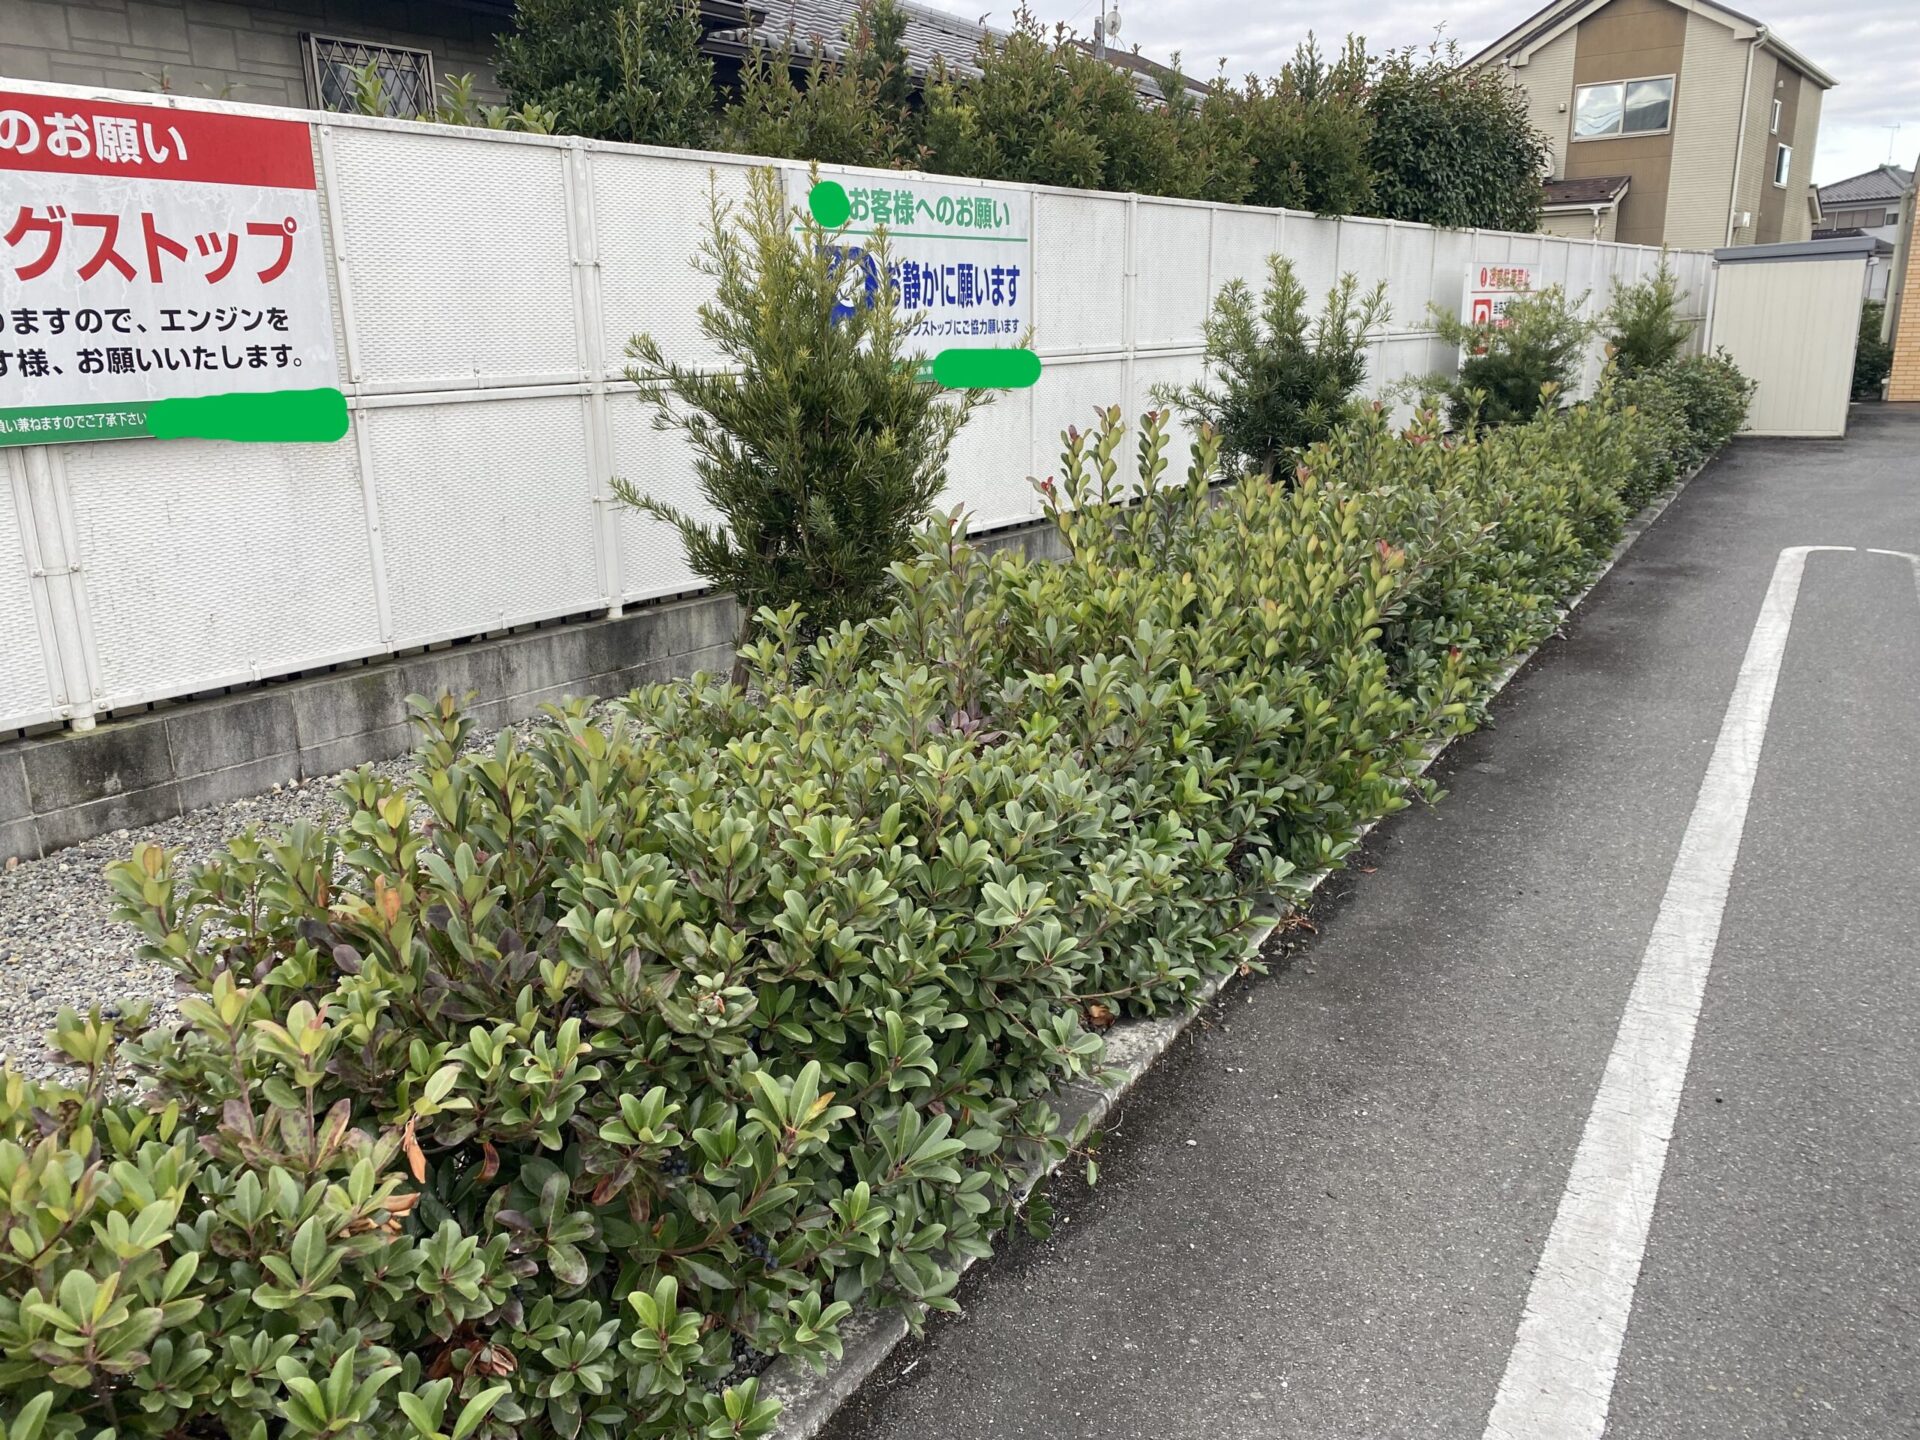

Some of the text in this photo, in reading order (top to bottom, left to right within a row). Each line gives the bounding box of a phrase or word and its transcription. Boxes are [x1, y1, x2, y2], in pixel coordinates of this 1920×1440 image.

[0, 110, 188, 164] のお願い
[848, 186, 1010, 229] お客様へのお願い
[4, 206, 297, 284] グストップ
[0, 307, 289, 335] ますので、エンジンを
